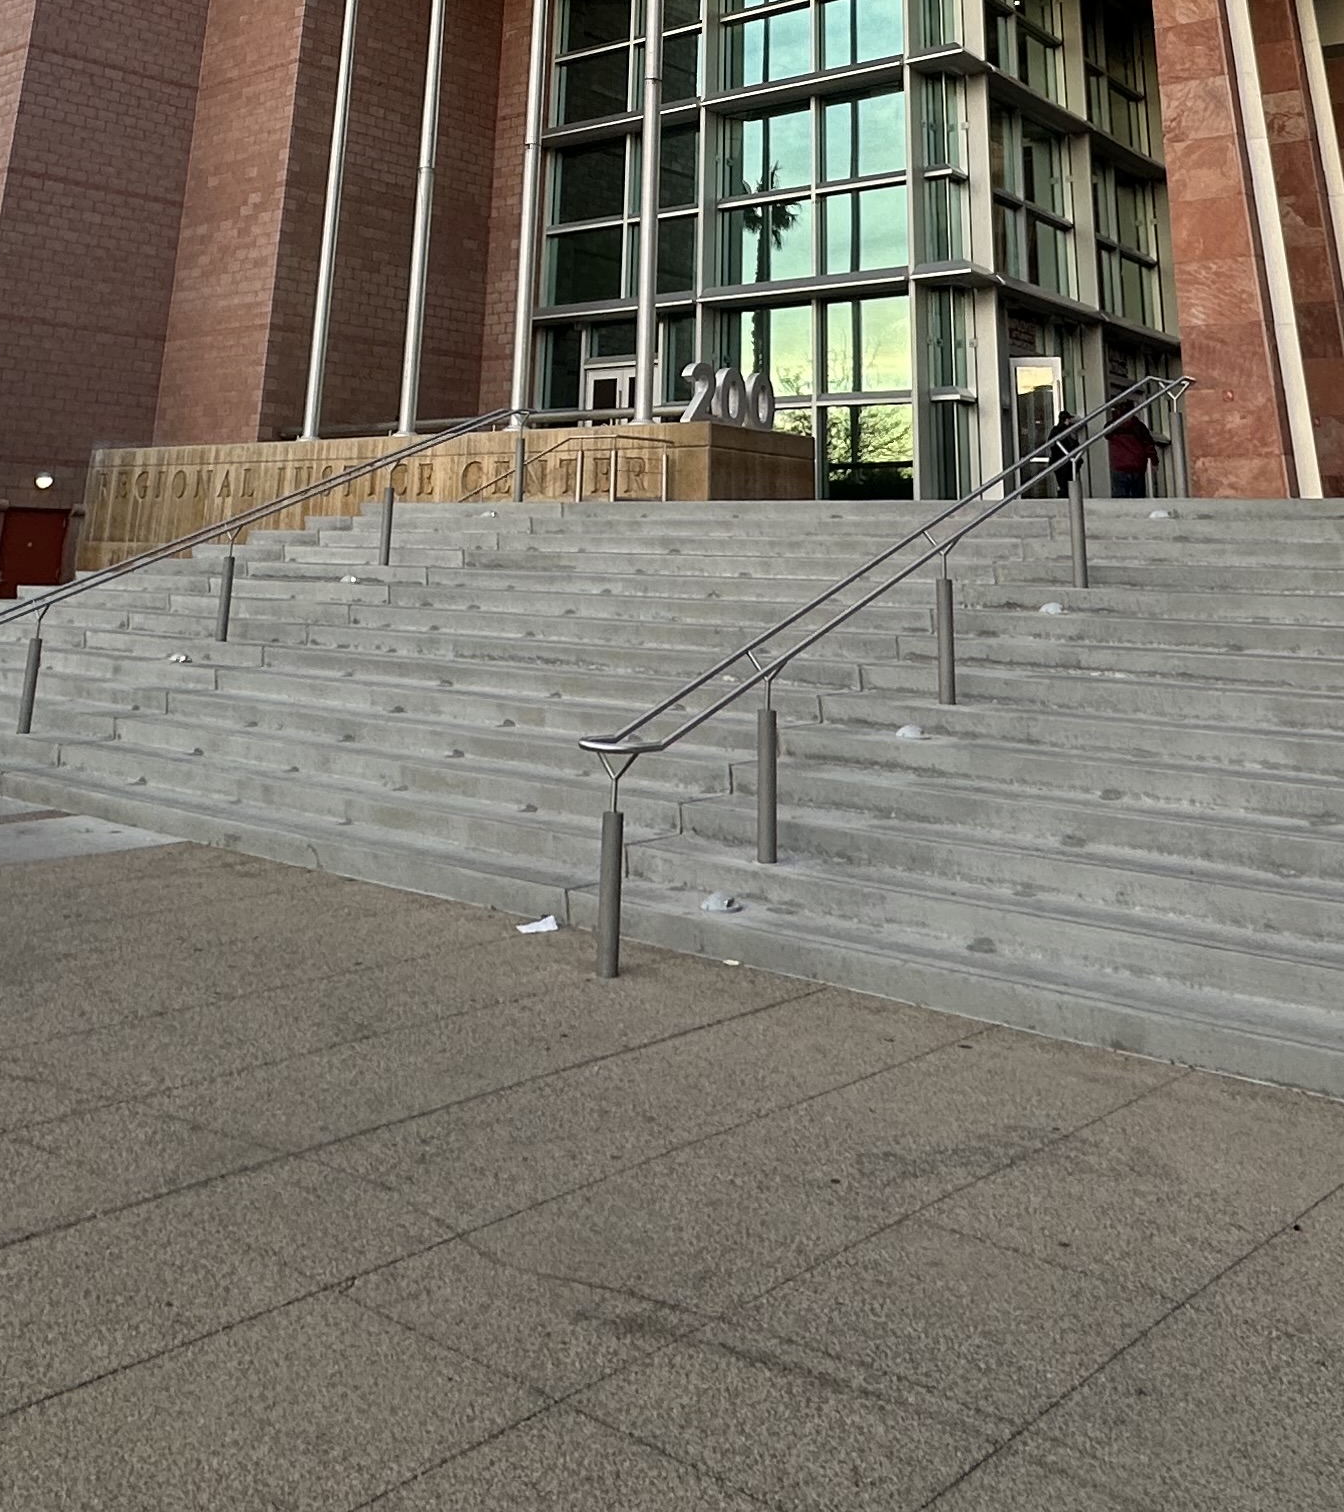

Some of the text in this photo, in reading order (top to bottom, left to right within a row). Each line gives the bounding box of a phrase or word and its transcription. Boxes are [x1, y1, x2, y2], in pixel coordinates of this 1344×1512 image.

[680, 362, 775, 431] 200
[98, 468, 255, 500] REGIONAL
[460, 456, 648, 496] CENTER
